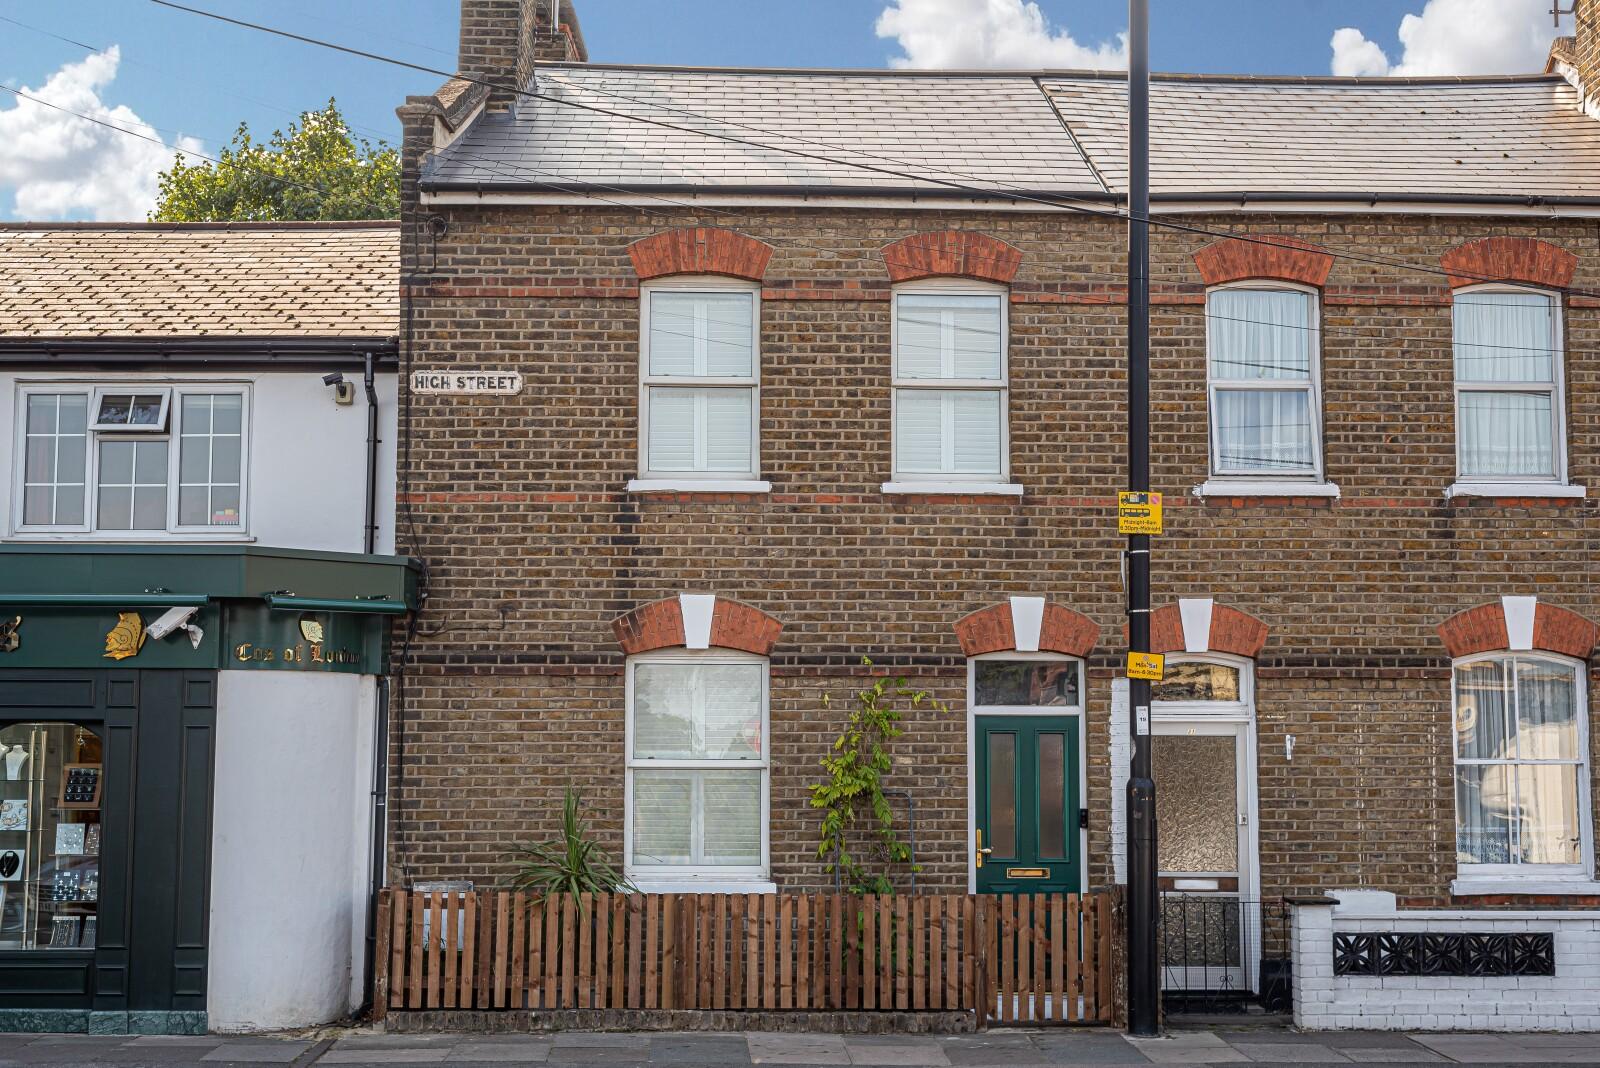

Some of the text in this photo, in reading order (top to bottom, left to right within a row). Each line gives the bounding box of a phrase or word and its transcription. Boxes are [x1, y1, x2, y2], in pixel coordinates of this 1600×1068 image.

[415, 376, 517, 389] HIGH STREET
[283, 643, 303, 663] of
